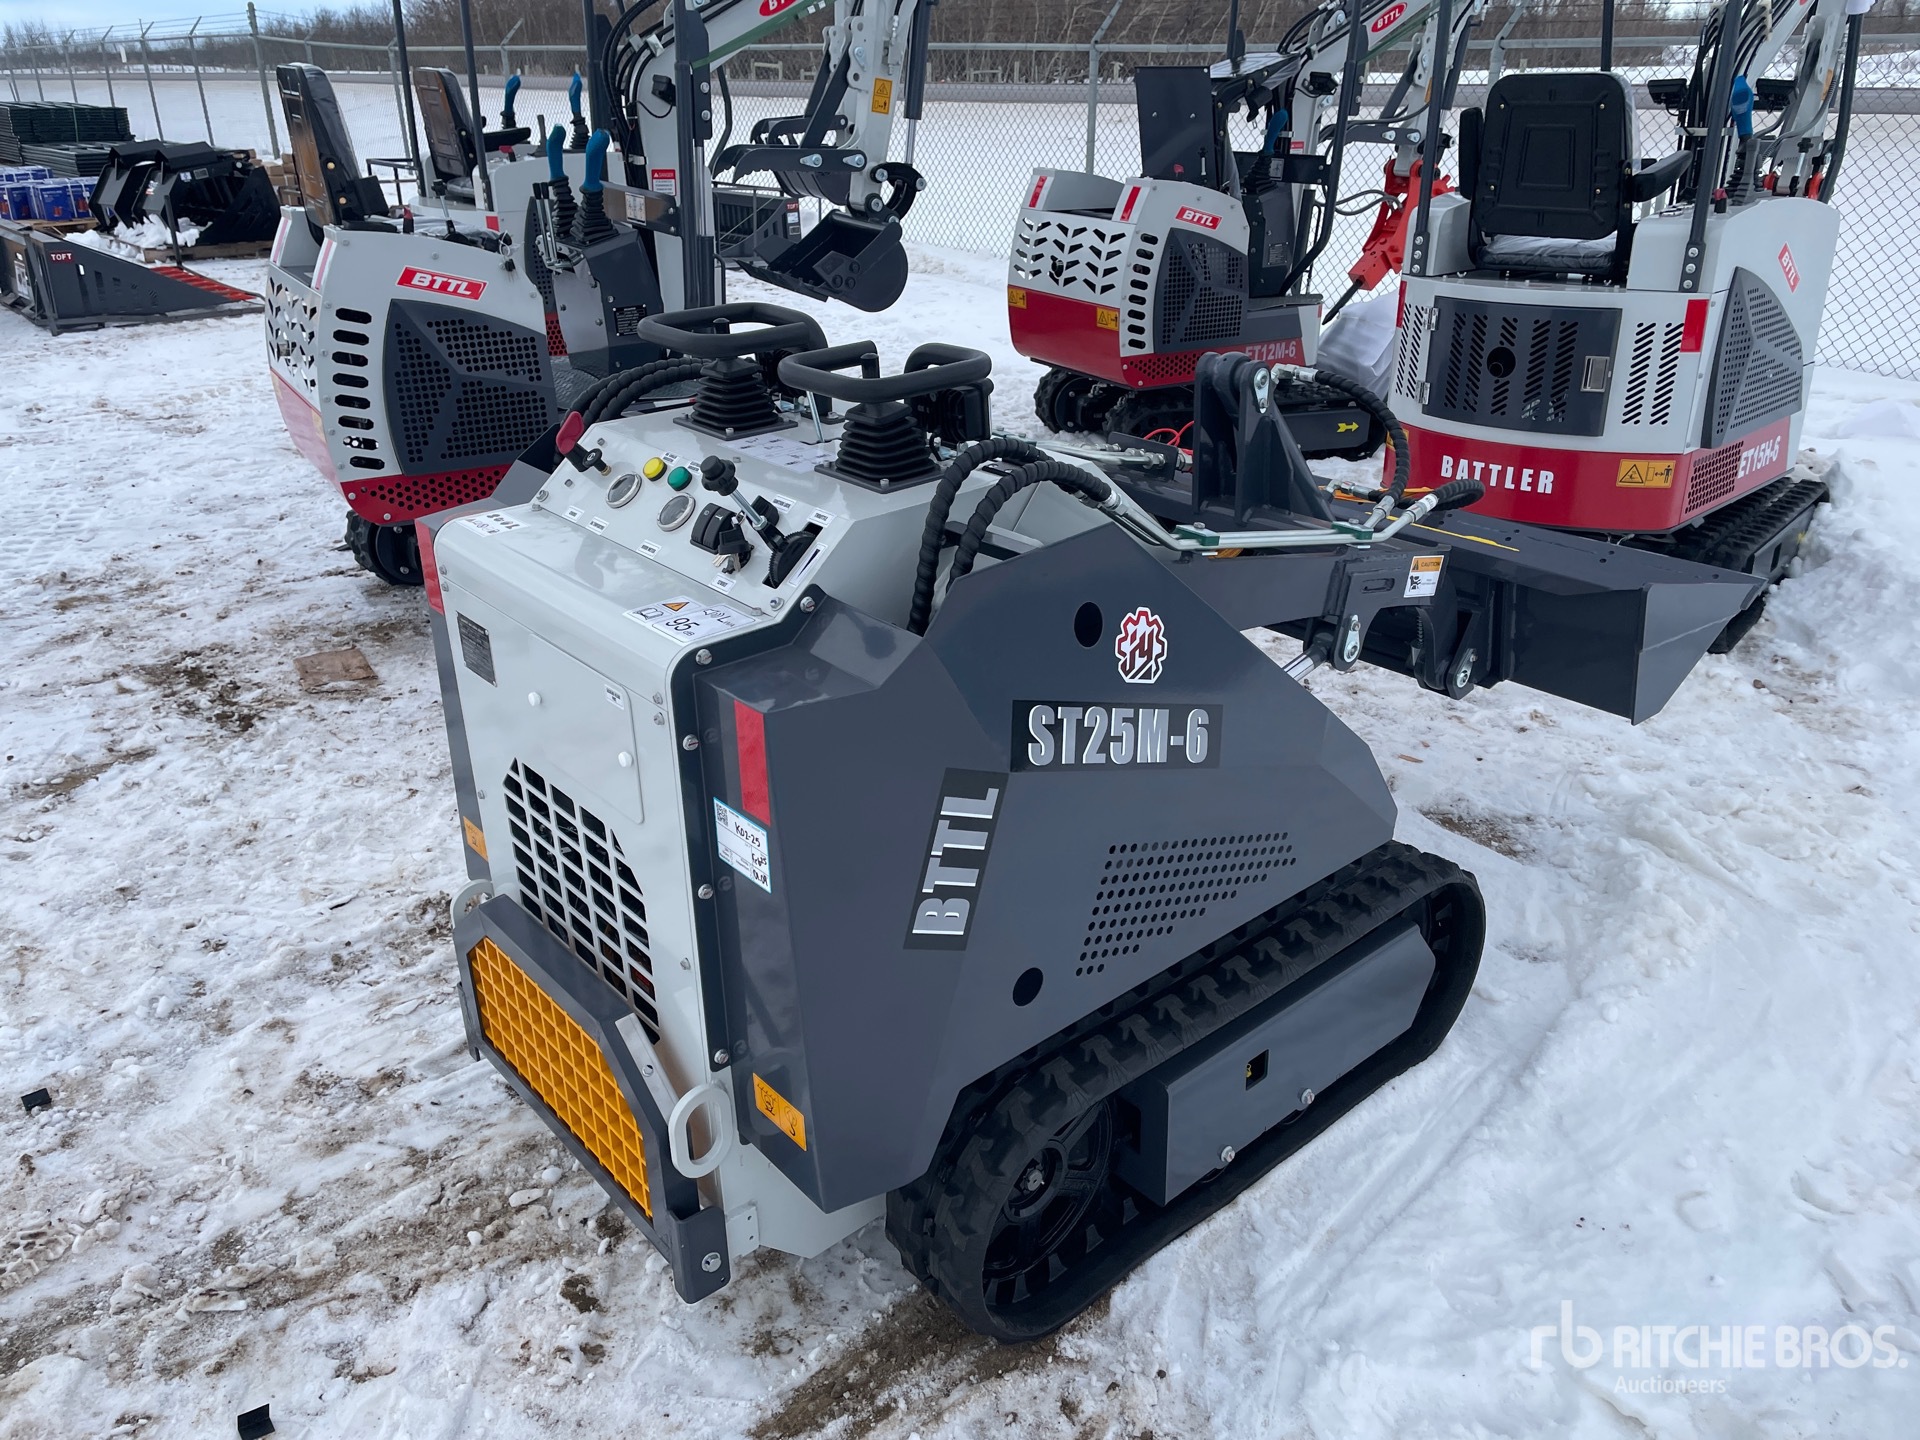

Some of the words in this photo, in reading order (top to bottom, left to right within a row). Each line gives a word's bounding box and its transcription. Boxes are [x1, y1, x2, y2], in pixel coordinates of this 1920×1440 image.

[1377, 8, 1400, 29] BTTL
[1183, 210, 1213, 226] BTTL
[51, 253, 72, 261] TOFT
[1782, 251, 1796, 286] BTTL
[411, 272, 472, 295] BTTL
[1737, 435, 1781, 479] ET15H-6
[1440, 455, 1554, 495] BATTLER
[665, 617, 700, 632] 95
[1027, 704, 1210, 766] ST25M-6
[912, 788, 999, 935] BTTL
